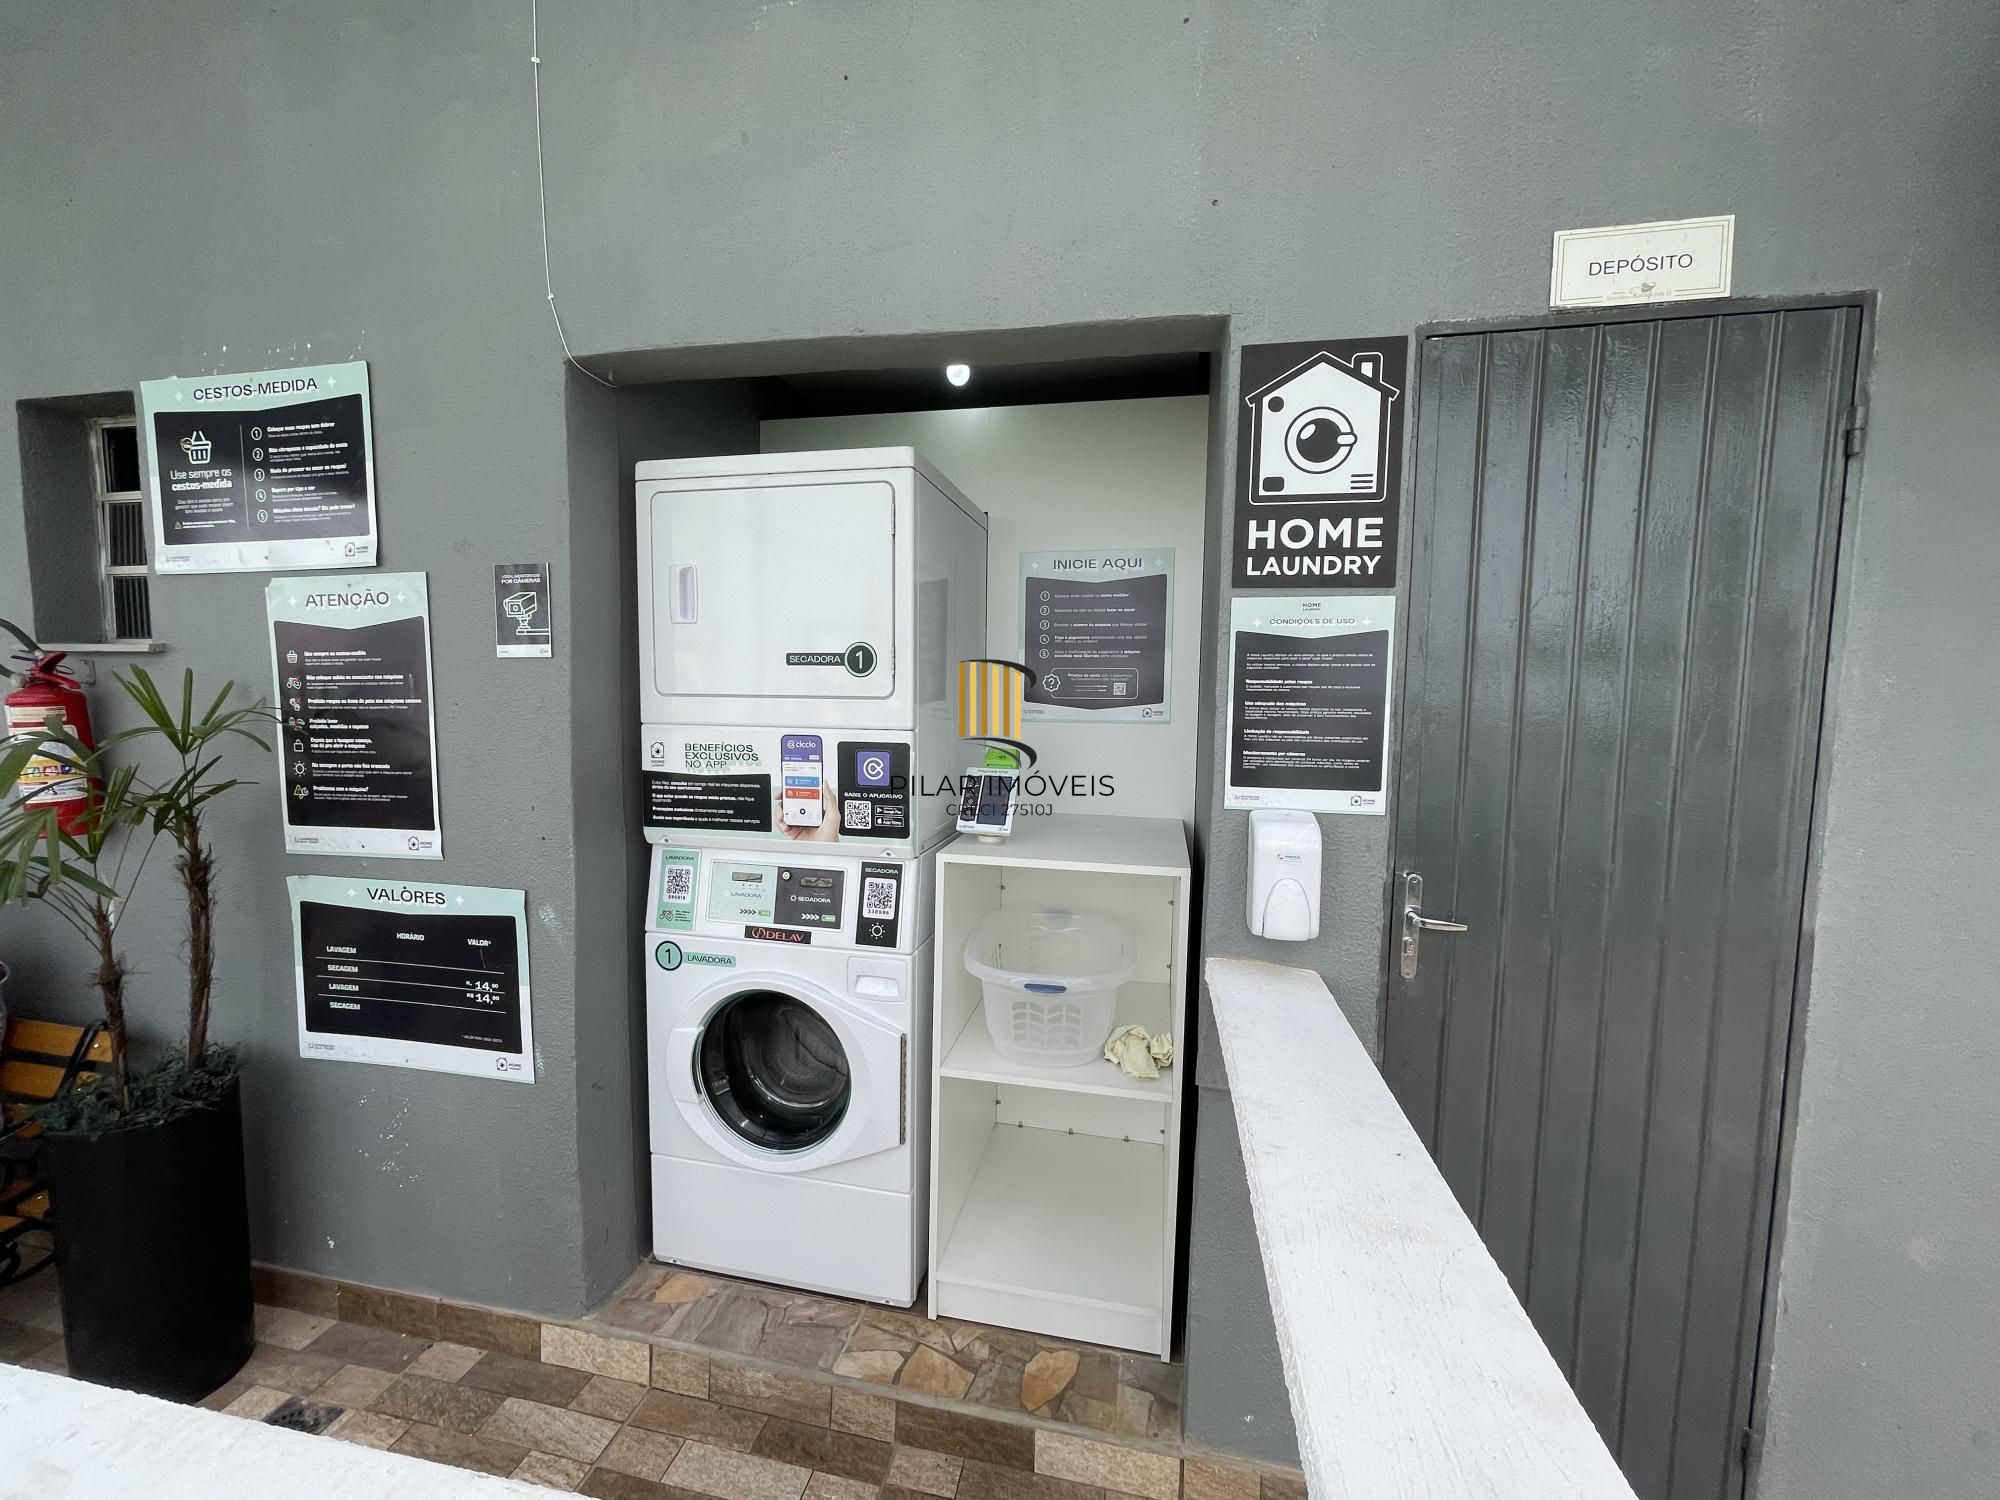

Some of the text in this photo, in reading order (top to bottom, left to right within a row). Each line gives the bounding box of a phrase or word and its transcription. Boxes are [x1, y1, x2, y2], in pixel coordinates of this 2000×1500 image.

[1589, 254, 1693, 275] DEPÓSITO
[193, 378, 317, 401] CESTOS-MEDIDA
[170, 470, 186, 480] Use
[189, 469, 220, 480] sempre
[172, 478, 232, 491] cestos-medida
[1248, 517, 1384, 549] HOME
[1053, 558, 1142, 570] INICIE AQUI
[1247, 555, 1381, 576] LAUNDRY
[306, 588, 389, 609] ATENÇÃO
[1269, 617, 1320, 626] CONDIÇÕES
[789, 651, 863, 668] SECADORA 1
[685, 742, 753, 752] BENEFÍCIOS
[685, 752, 758, 761] EXCLUSIVOS
[367, 887, 446, 905] VALORES
[397, 932, 424, 941] HORÁRIO
[766, 932, 804, 941] DELAV
[327, 946, 356, 954] LAVAGEM
[665, 949, 732, 965] 1 LAVADORA
[328, 965, 358, 973] SECAGEM
[329, 983, 359, 992] LAVAGEM
[330, 1002, 360, 1010] SECAGEM
